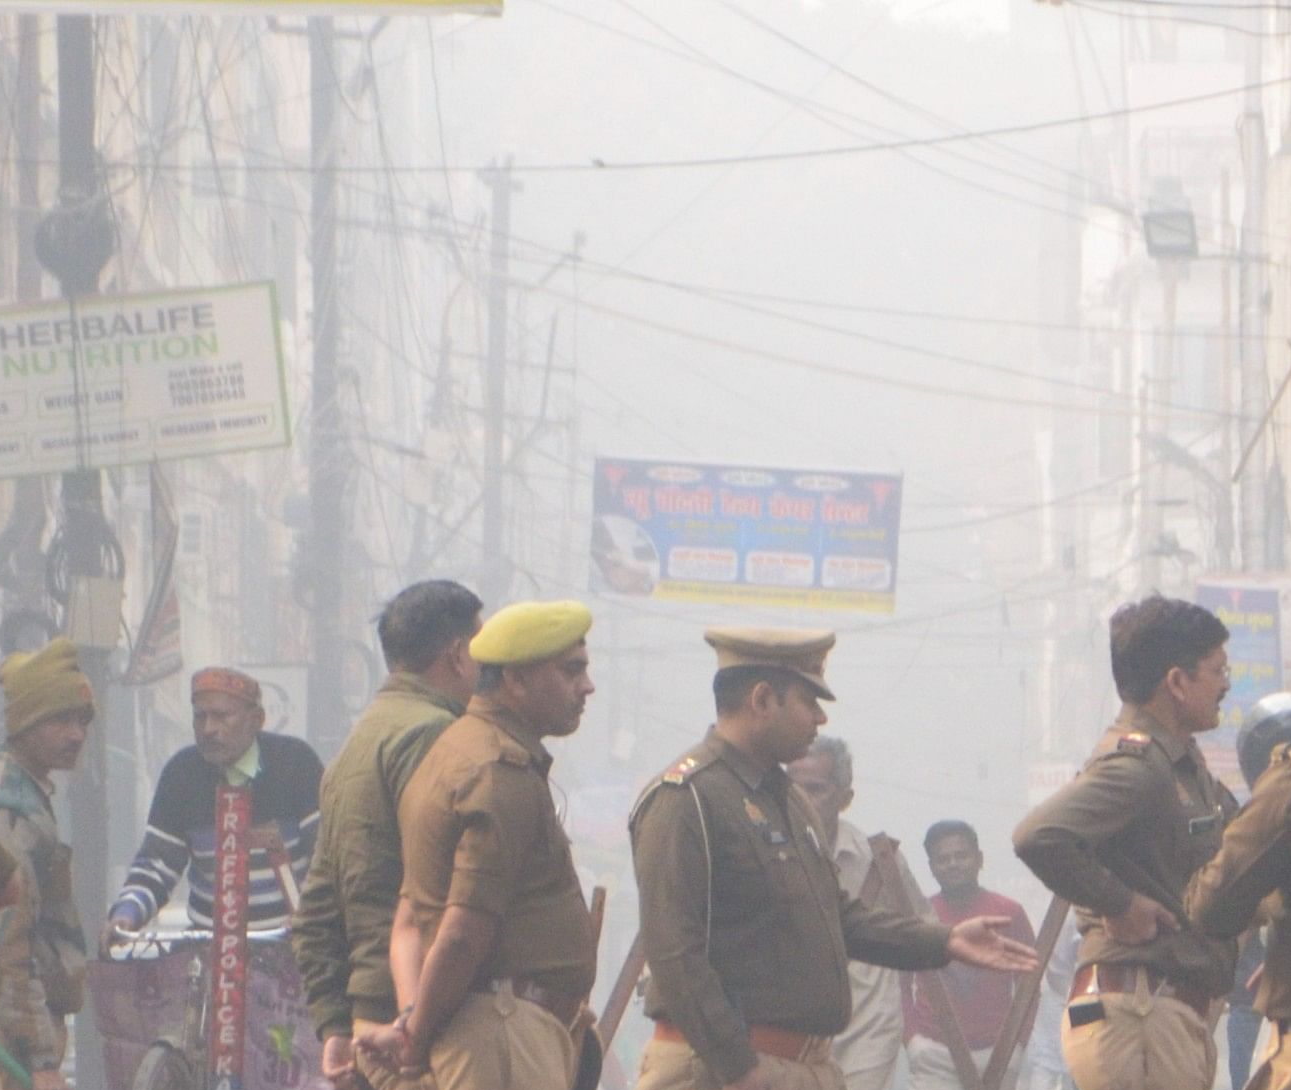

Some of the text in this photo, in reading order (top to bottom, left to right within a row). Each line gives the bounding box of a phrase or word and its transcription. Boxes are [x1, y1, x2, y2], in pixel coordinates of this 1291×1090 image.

[1, 332, 220, 379] NUTRITION
[220, 792, 240, 931] TRAFFIC
[217, 935, 239, 1045] POLICE
